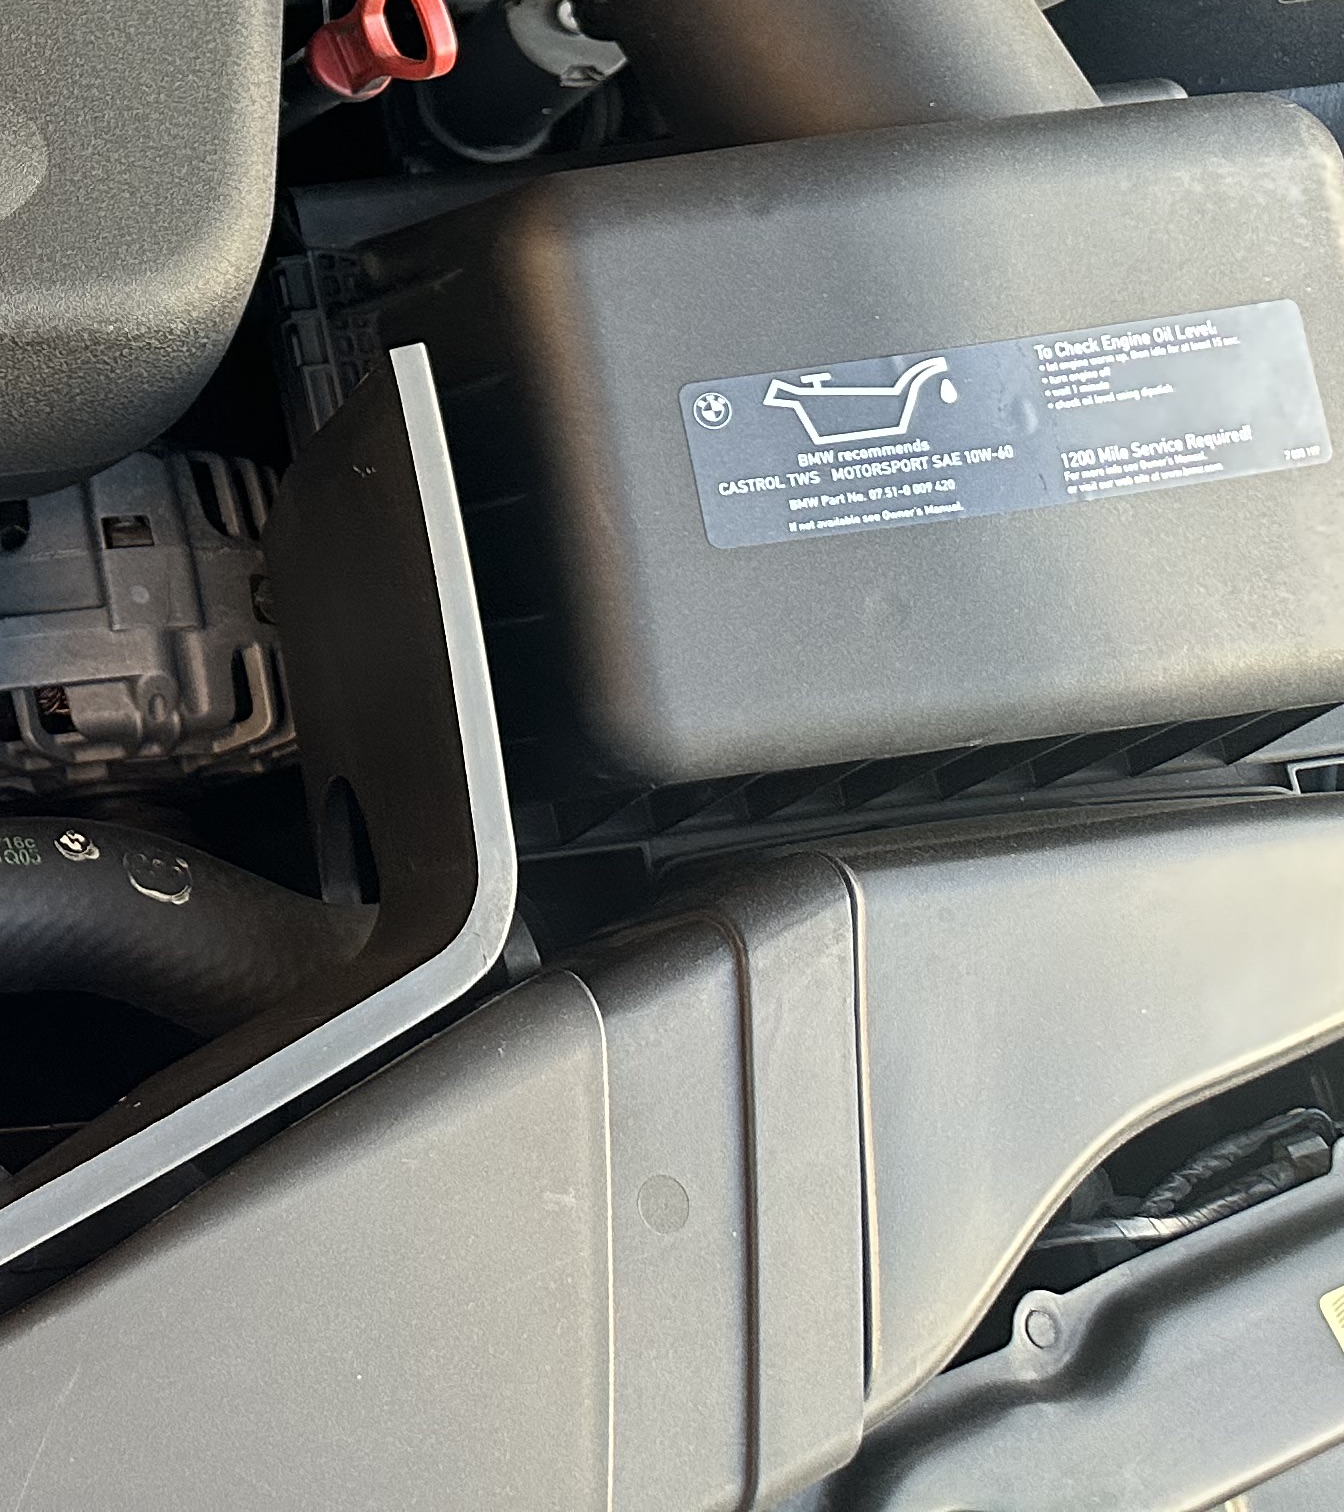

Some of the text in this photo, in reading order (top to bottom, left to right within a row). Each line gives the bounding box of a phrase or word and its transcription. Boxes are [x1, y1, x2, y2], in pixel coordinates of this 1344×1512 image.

[1033, 344, 1052, 360] To
[1054, 337, 1100, 357] Check
[1100, 331, 1150, 351] Engine
[1152, 325, 1174, 342] Oil
[797, 439, 930, 467] BMW recommends
[1060, 424, 1253, 468] 1200 Mile Service Required!
[718, 445, 1013, 496] CASTROL TWS MOTORSPORT SAE 10W-60
[788, 496, 818, 510] BMW
[820, 493, 845, 506] Part
